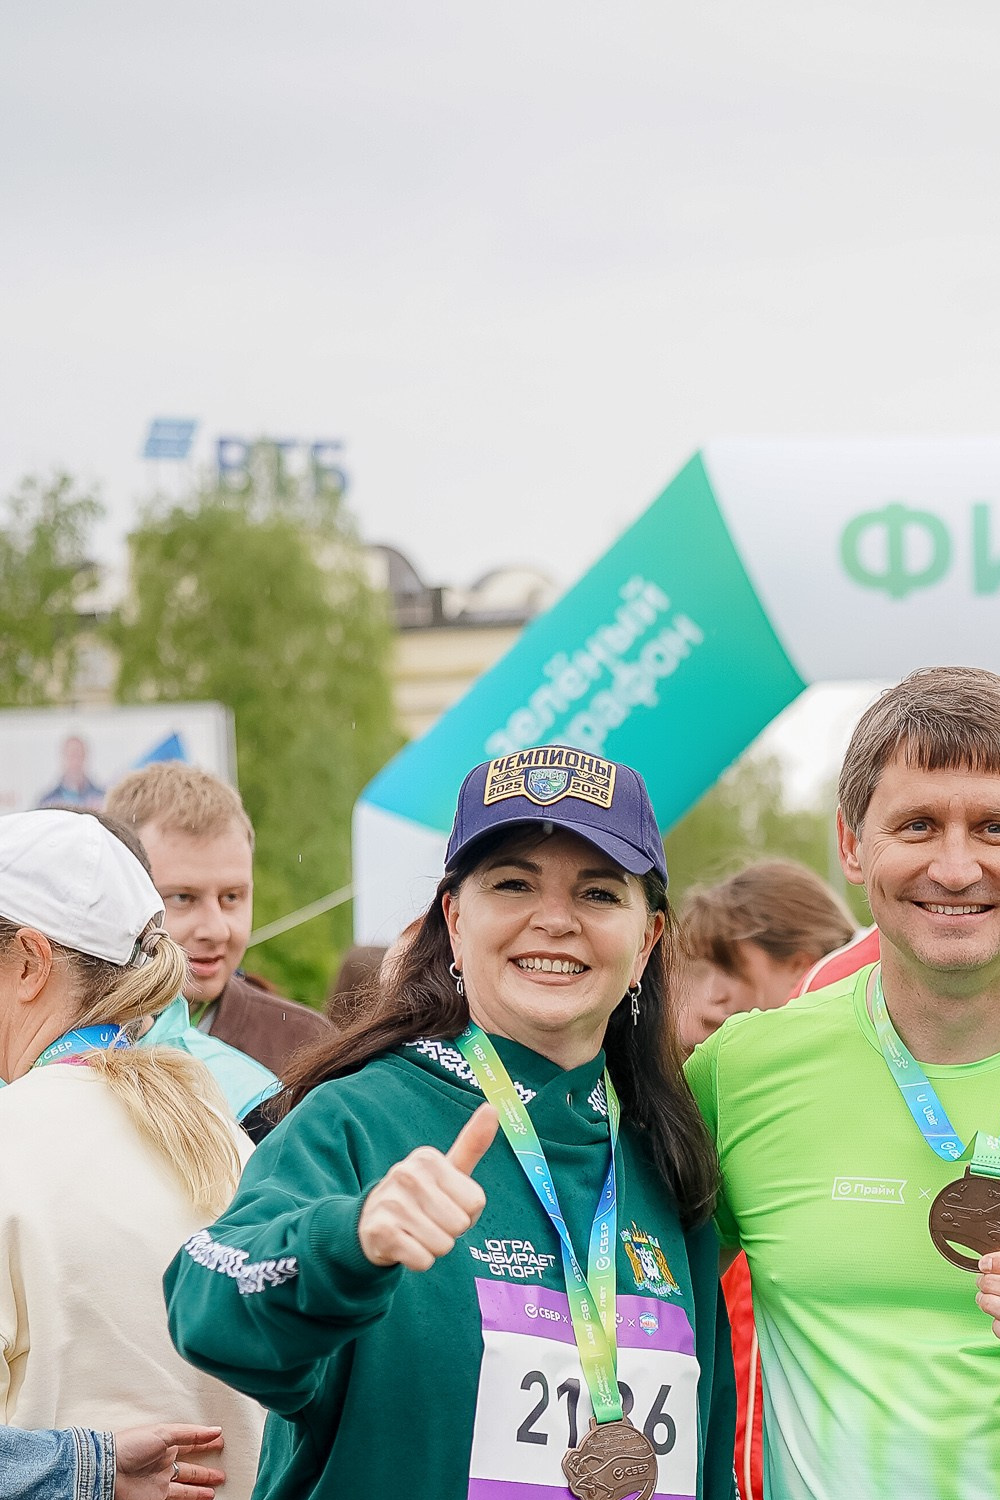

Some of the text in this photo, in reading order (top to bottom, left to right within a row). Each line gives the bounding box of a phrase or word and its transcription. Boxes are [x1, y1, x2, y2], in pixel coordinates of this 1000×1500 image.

[215, 435, 349, 496] ВТБ
[548, 612, 704, 756] рафон
[493, 749, 613, 779] ЧЕМПИОНЫ
[488, 780, 523, 798] 2025
[572, 780, 609, 801] 2026
[43, 1041, 73, 1060] СБЕР
[472, 1043, 487, 1062] 185
[922, 1104, 939, 1127] Utair
[853, 1183, 895, 1196] Прайм
[484, 1239, 536, 1254] ЮГРА
[599, 1221, 609, 1255] СБЕР
[468, 1246, 556, 1268] ВЫБИРАЕТ
[489, 1263, 546, 1280] СПОРТ
[539, 1307, 561, 1322] СБЕР
[579, 1298, 592, 1321] 185
